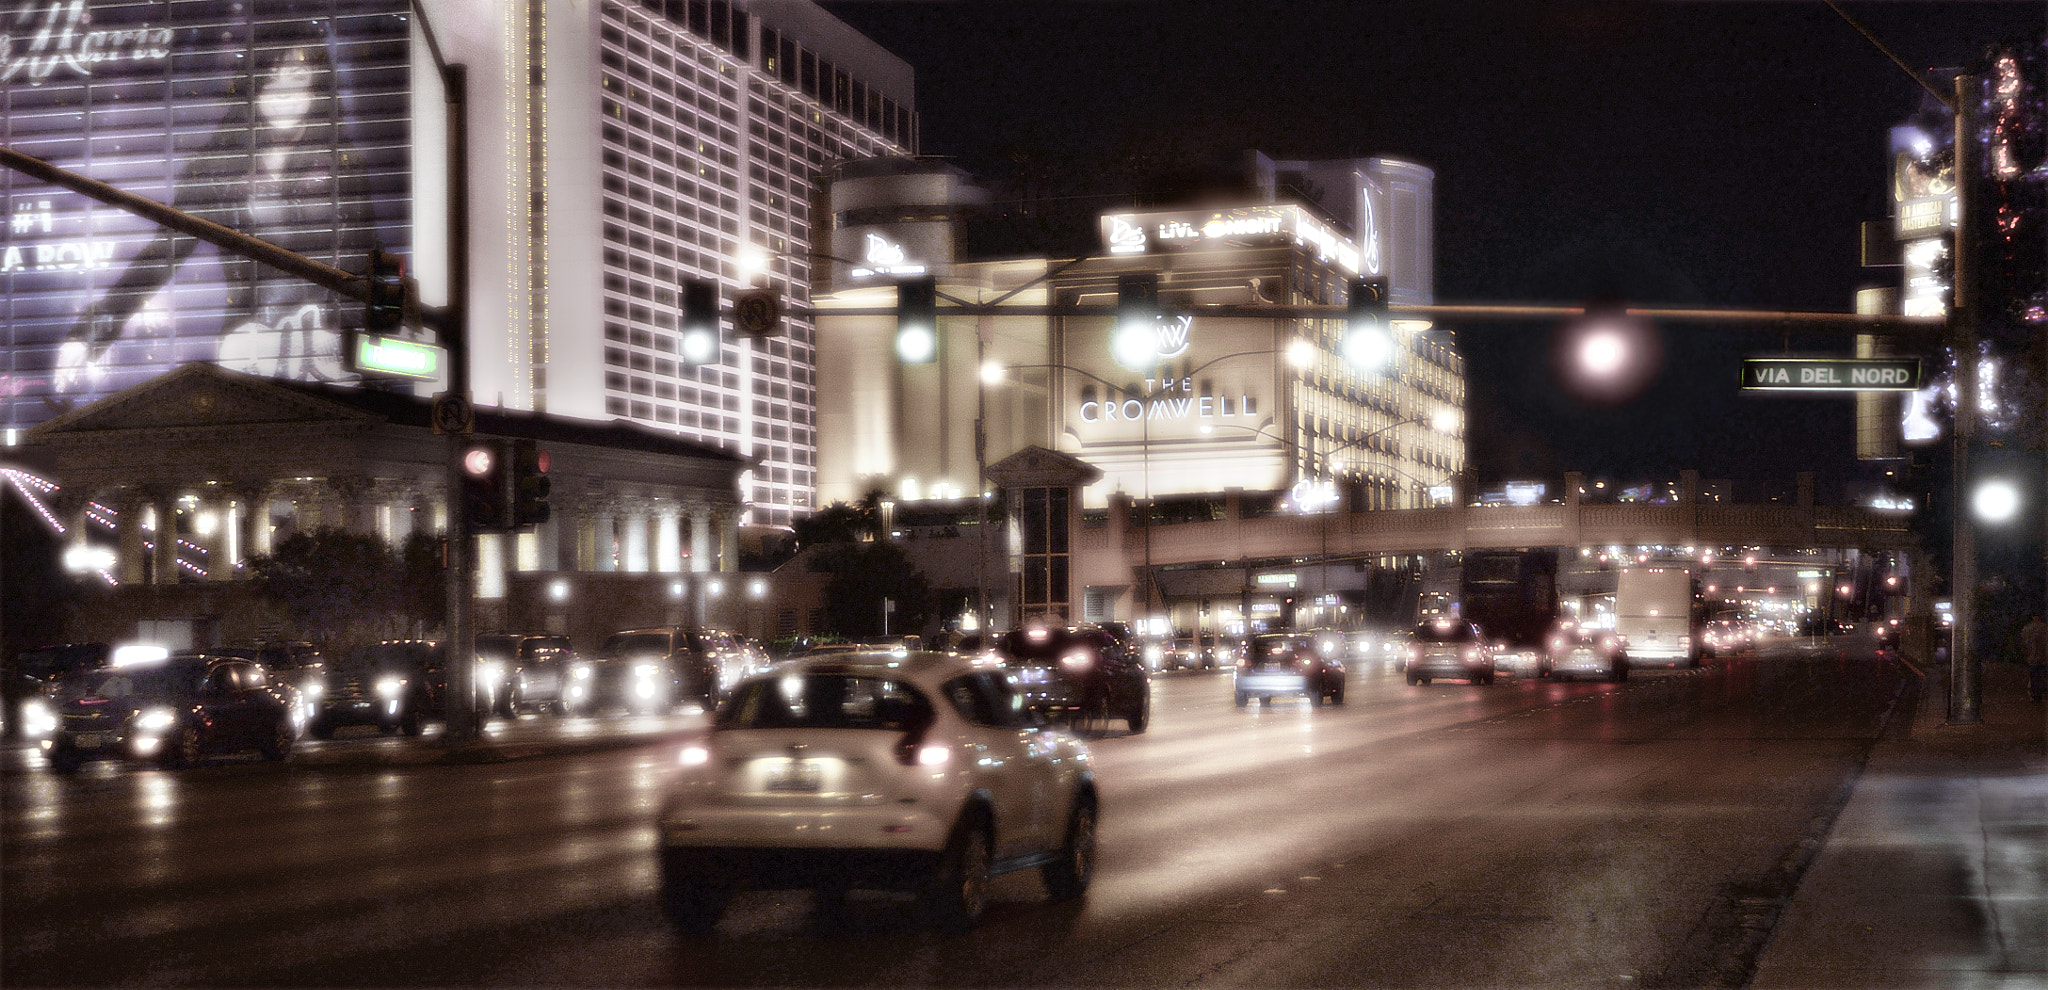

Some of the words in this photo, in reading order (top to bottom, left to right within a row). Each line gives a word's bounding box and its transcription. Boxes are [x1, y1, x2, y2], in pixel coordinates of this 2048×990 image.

[11, 201, 52, 233] #1
[0, 246, 25, 272] A
[36, 242, 116, 271] ROW
[1145, 377, 1192, 393] THE
[1755, 367, 1790, 383] VIA
[1800, 367, 1842, 384] DEL
[1851, 368, 1910, 384] NORD
[1079, 394, 1257, 424] CROMWELL
